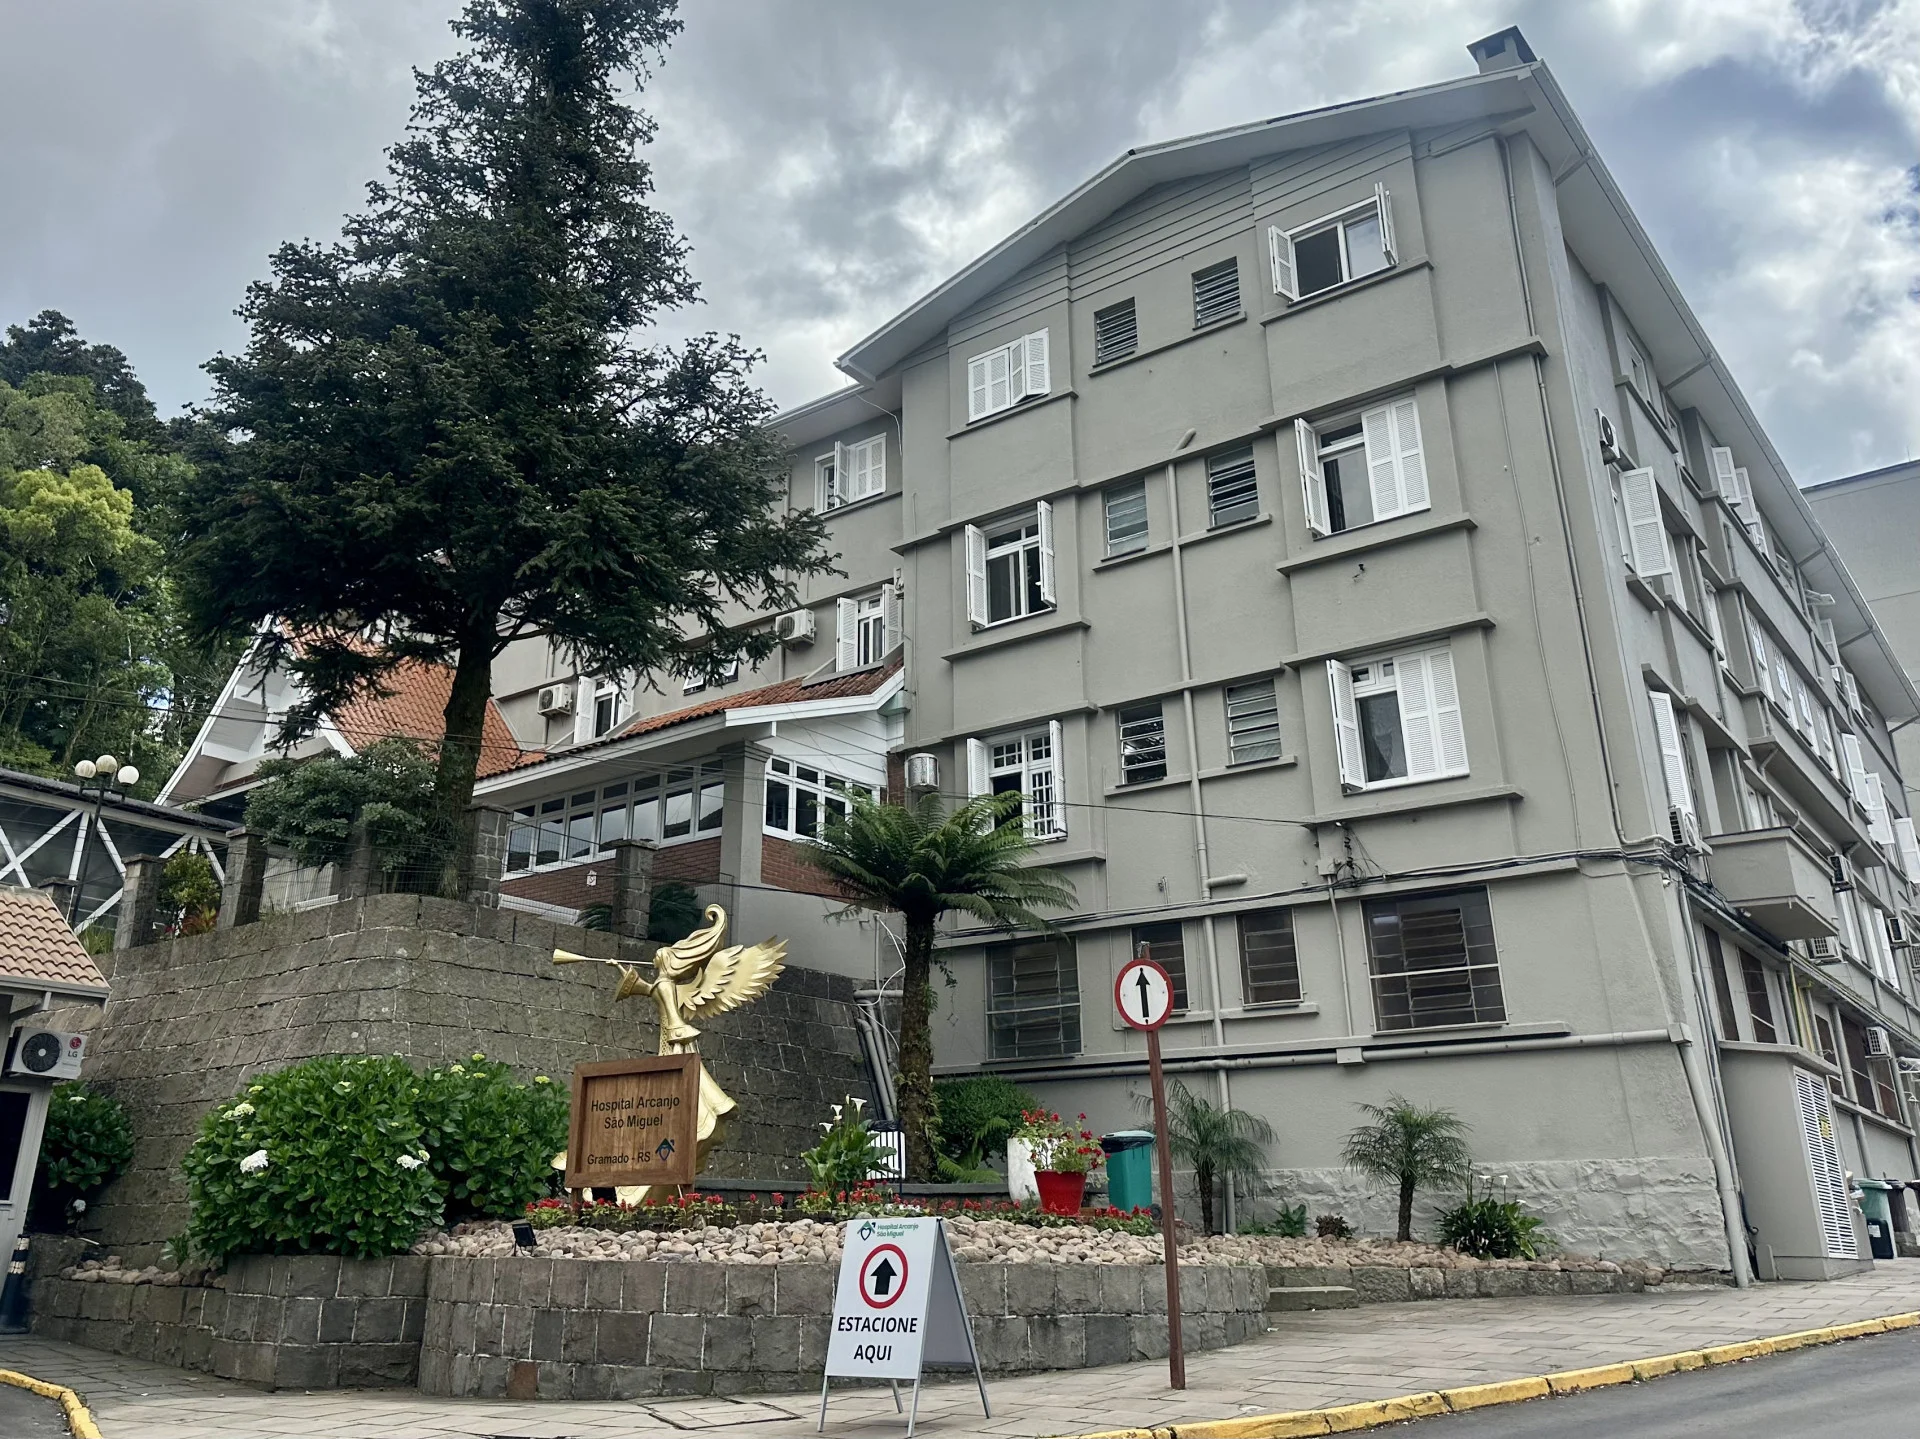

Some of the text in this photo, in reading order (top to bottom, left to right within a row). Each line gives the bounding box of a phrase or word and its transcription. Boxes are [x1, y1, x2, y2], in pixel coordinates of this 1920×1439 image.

[592, 1094, 680, 1113] Hospital Arcanjo
[604, 1114, 663, 1130] São Miguel
[587, 1153, 629, 1165] Gramado
[637, 1151, 651, 1163] RS
[899, 1223, 919, 1231] Arcanjo
[837, 1316, 918, 1333] ESTACIONE
[853, 1344, 893, 1363] AQUI
